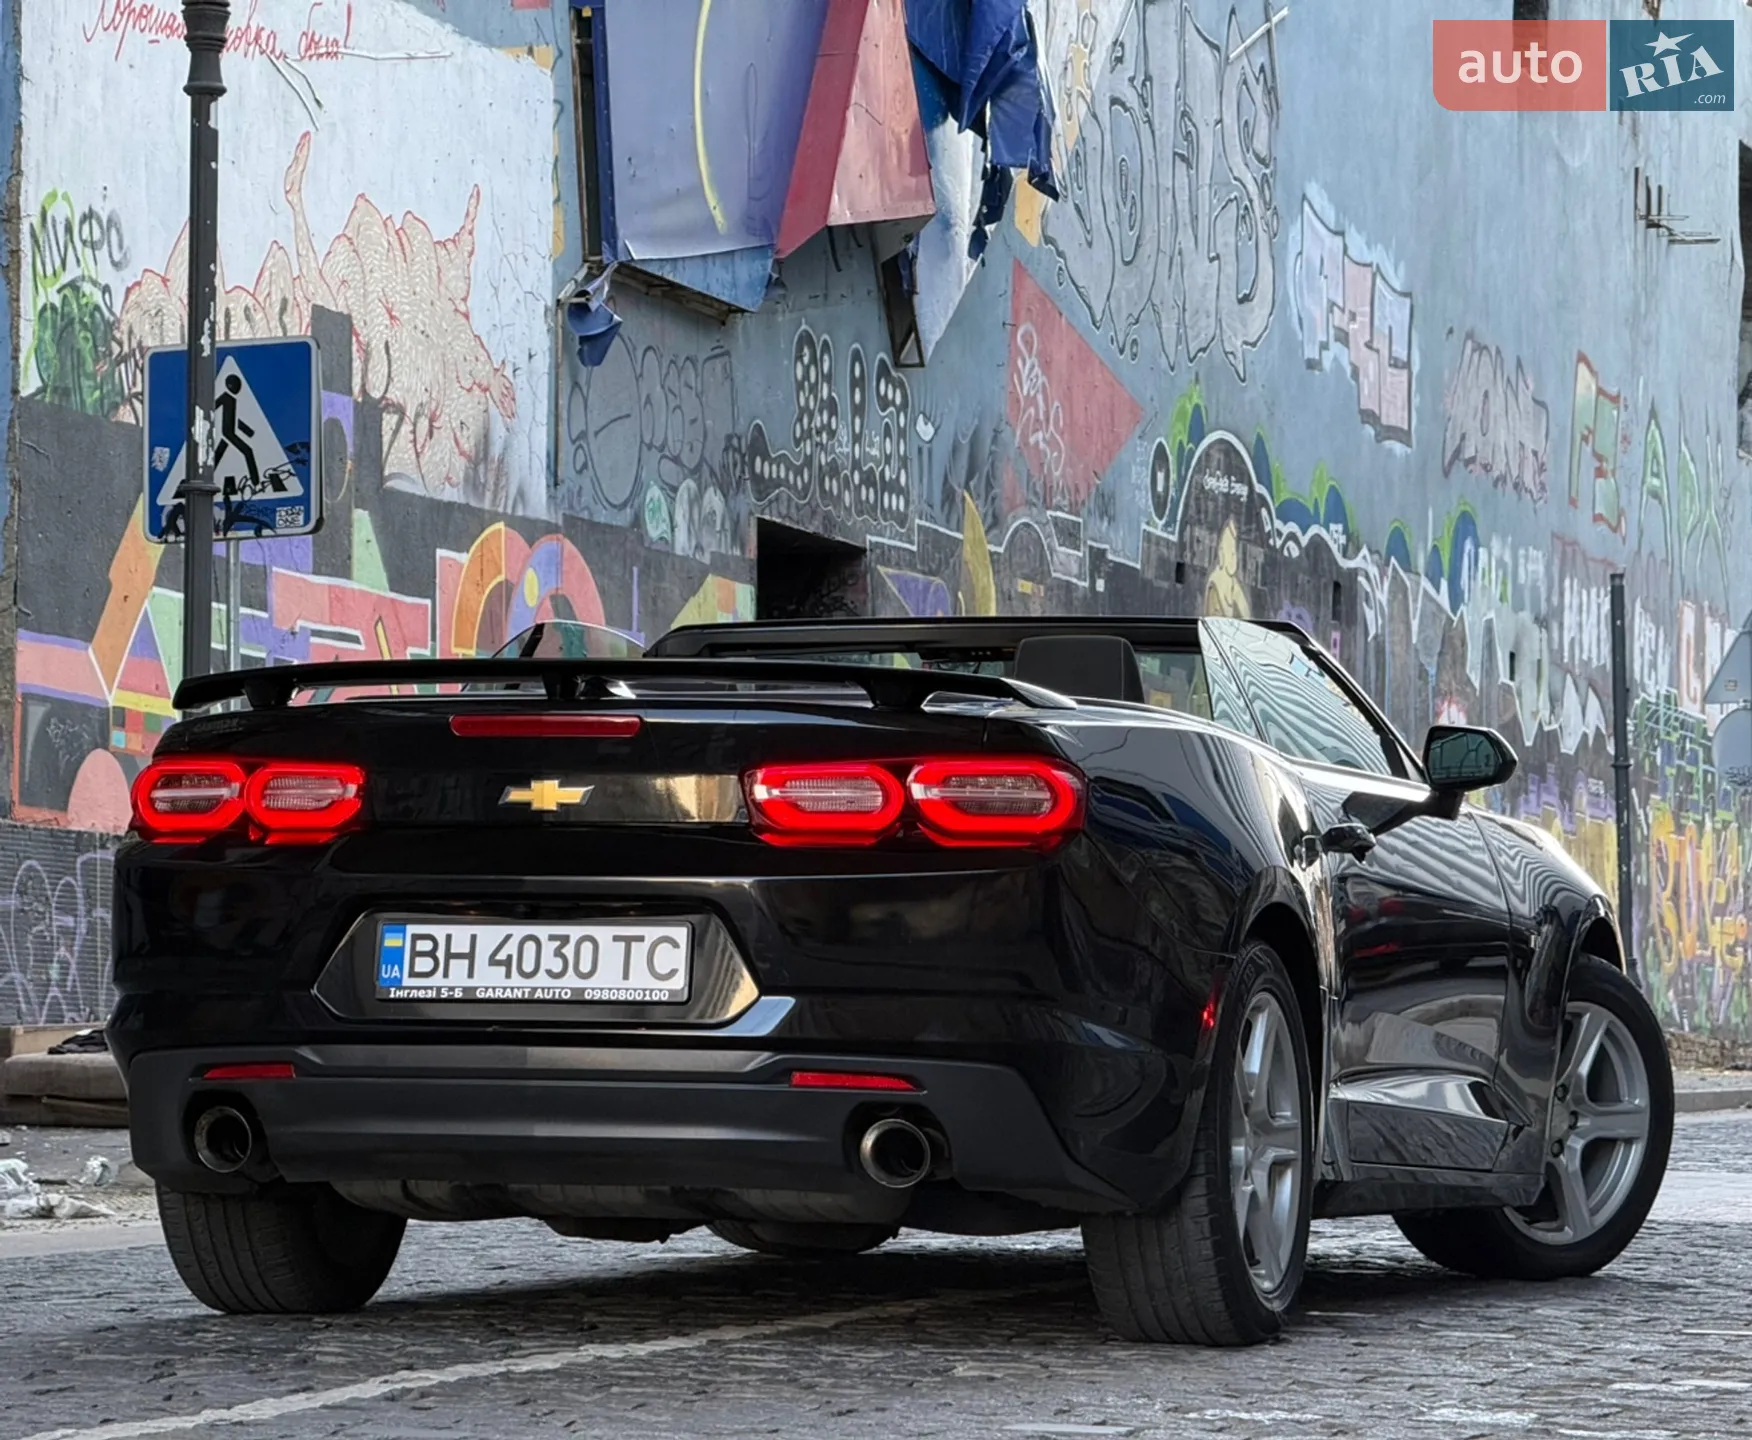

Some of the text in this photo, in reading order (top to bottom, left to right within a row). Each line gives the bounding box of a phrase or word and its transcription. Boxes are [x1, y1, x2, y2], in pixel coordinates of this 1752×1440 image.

[407, 933, 681, 982] BH 4030 TC
[381, 964, 401, 979] UA
[389, 987, 463, 999] Інглезі 5-Б
[475, 987, 669, 1001] GARANT AUTO 0980800100
